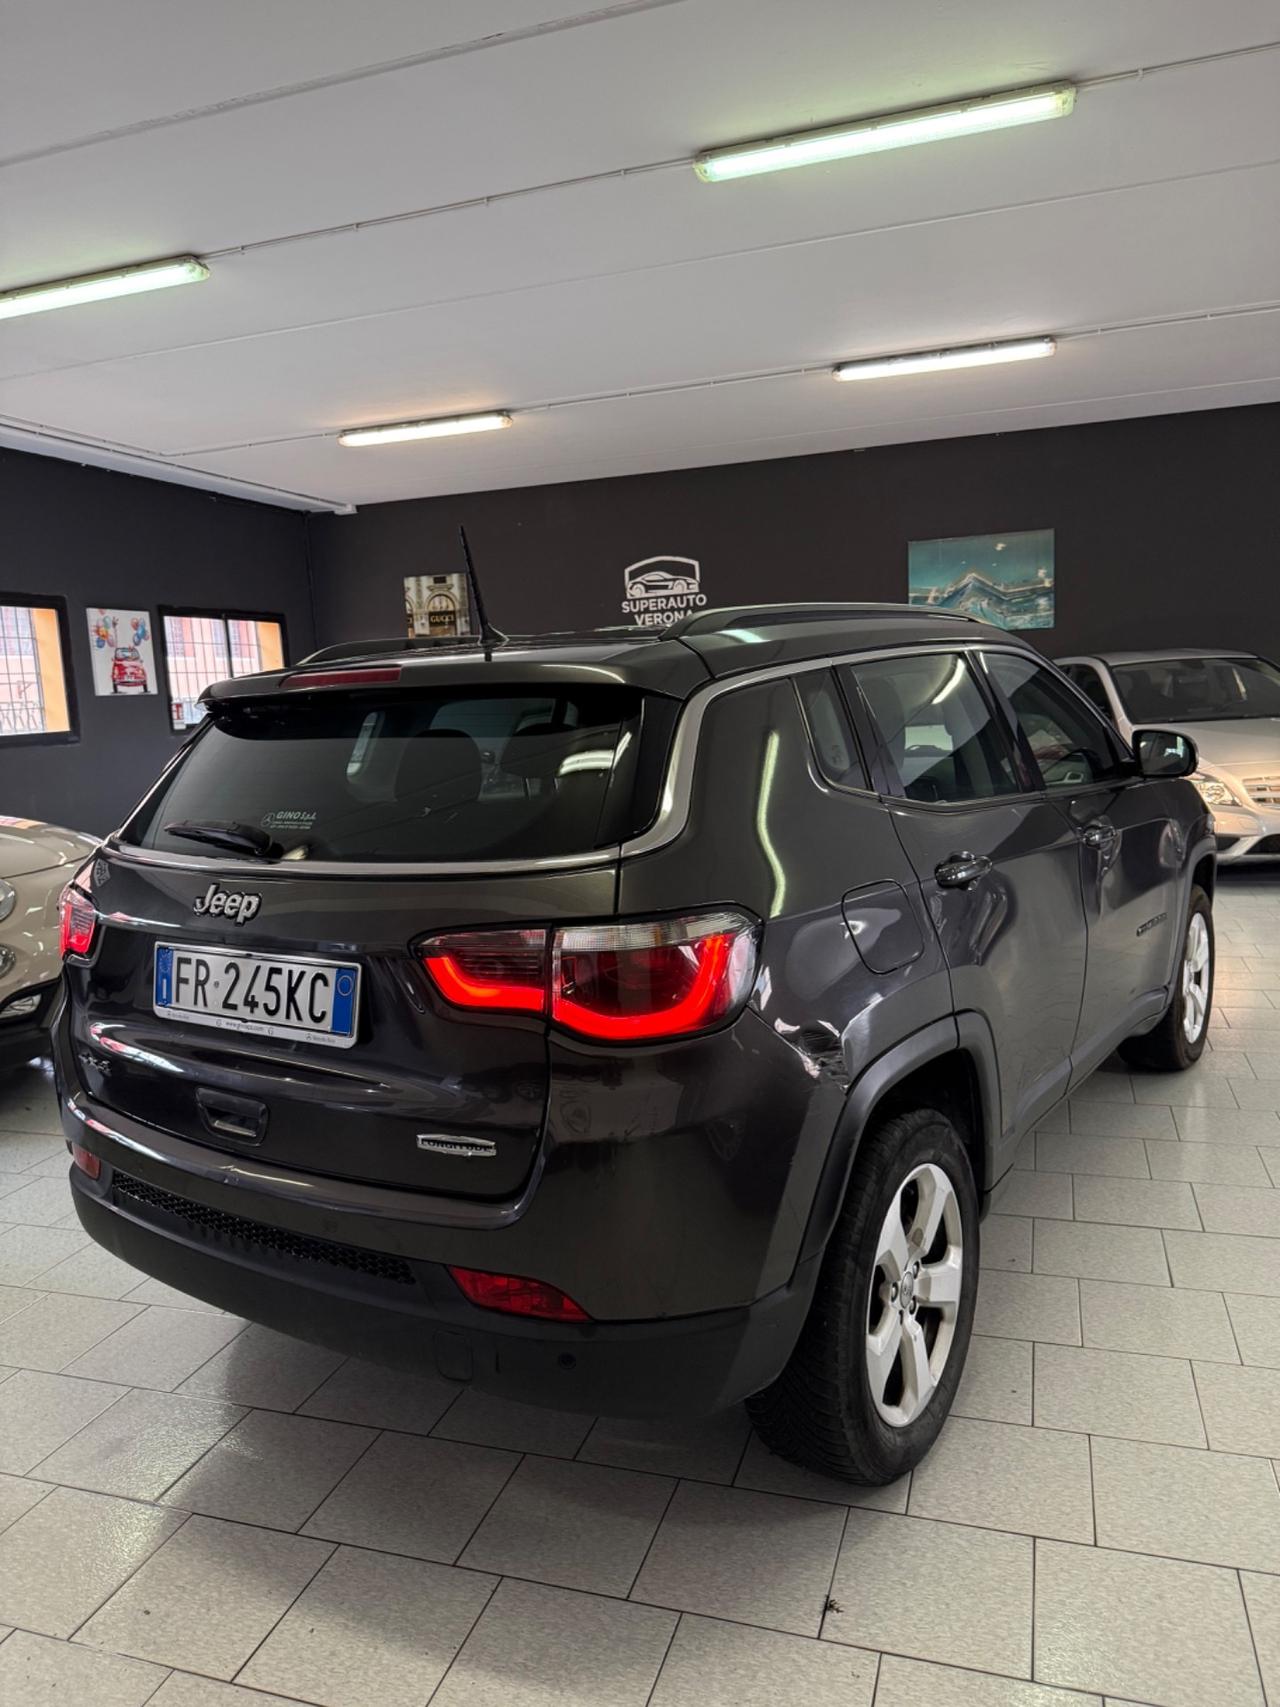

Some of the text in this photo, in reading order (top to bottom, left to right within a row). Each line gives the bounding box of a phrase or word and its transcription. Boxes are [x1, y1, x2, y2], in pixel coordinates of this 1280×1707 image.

[621, 594, 707, 613] SUPERAUTO
[276, 811, 301, 820] GINO
[193, 883, 261, 925] Jeep
[174, 956, 330, 1024] FR 245KC
